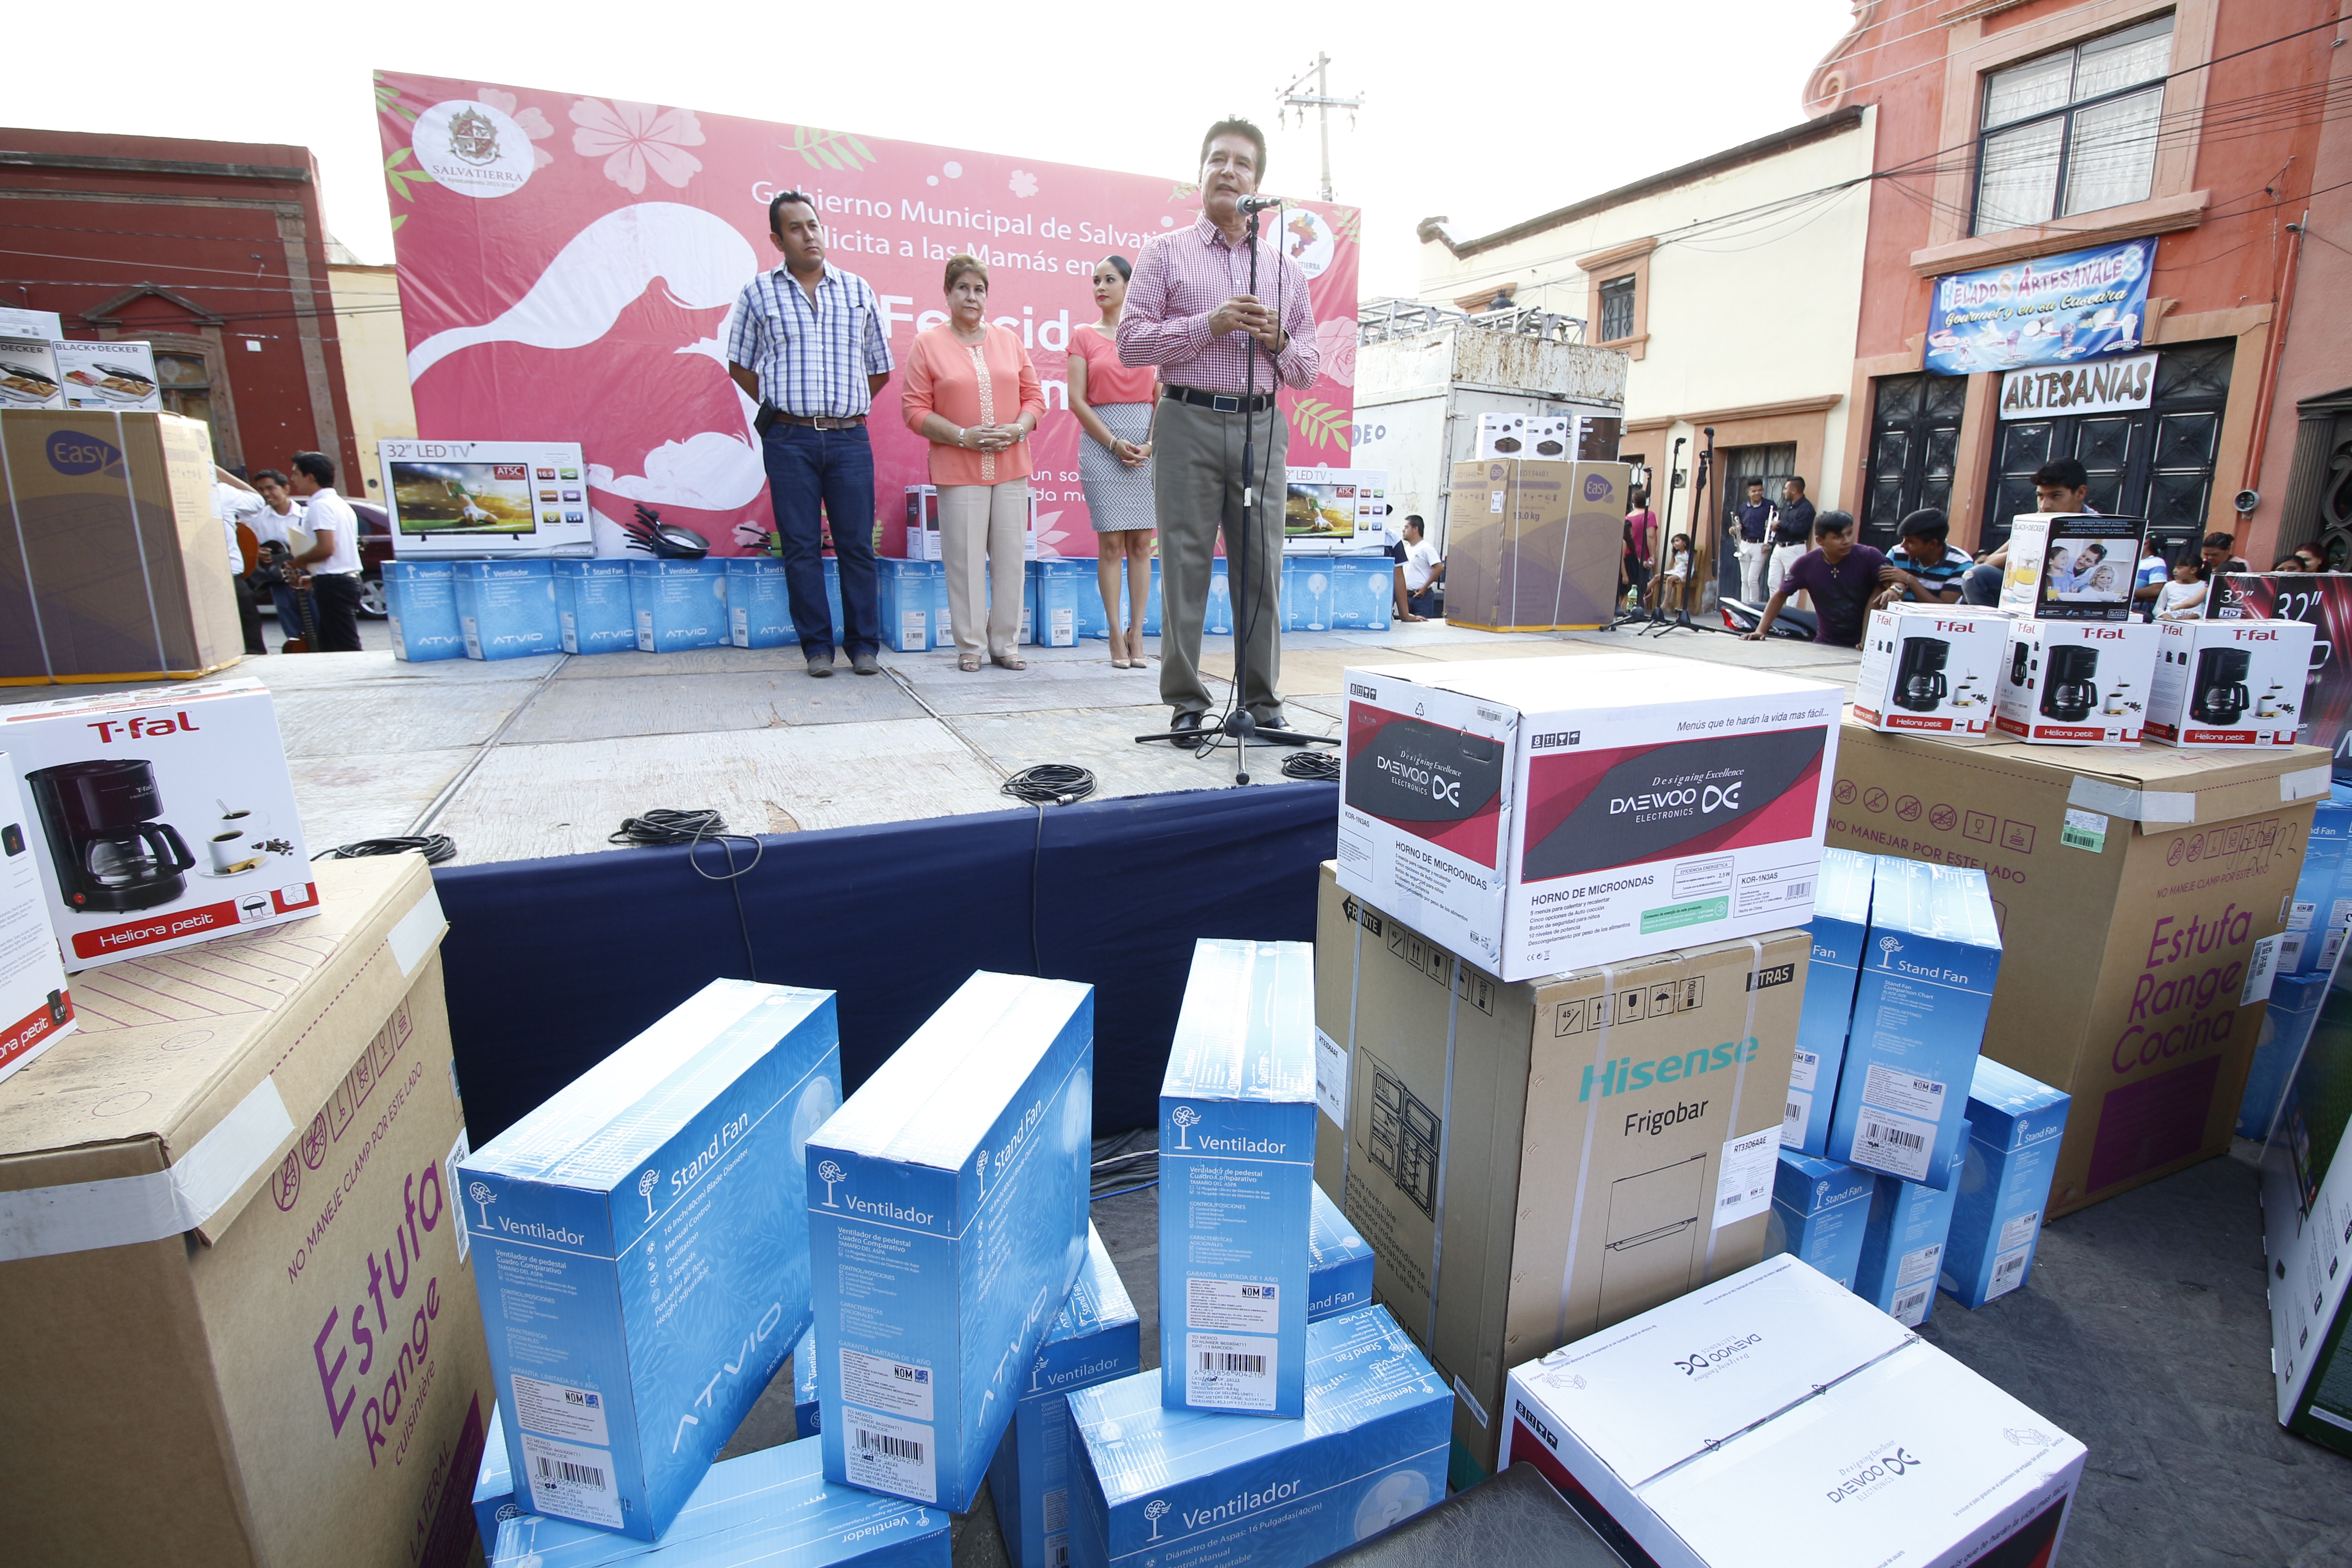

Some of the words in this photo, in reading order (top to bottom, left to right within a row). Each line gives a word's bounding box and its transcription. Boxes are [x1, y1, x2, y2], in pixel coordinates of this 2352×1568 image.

[432, 165, 524, 182] SALVATIERRA
[901, 198, 1032, 237] Municipal
[1040, 216, 1072, 240] de
[1079, 221, 1157, 250] Salvat
[823, 225, 890, 255] licita
[899, 239, 914, 258] a
[922, 236, 957, 262] las
[966, 242, 1058, 273] Mamás
[1065, 260, 1095, 277] en
[1298, 261, 1320, 270] TIERRA
[1941, 274, 2013, 311] HELADOS
[2017, 245, 2144, 298] ARTESANALES
[1945, 306, 2004, 328] Gourmet
[2003, 307, 2013, 320] y
[2017, 304, 2035, 316] en
[2037, 301, 2057, 313] su
[2060, 289, 2127, 310] Cascara
[55, 343, 139, 353] BLACK+DECKER
[2004, 362, 2151, 410] ARTESANIAS
[54, 442, 108, 468] Easy
[416, 445, 446, 458] LED
[449, 446, 470, 458] TV
[496, 467, 522, 476] ATSC
[1296, 470, 1313, 481] LED
[1314, 471, 1327, 481] TV
[1586, 480, 1609, 496] Easy
[2014, 524, 2045, 532] BLACK+DECKER
[593, 567, 611, 576] Stand
[666, 627, 707, 638] ATVIO
[1876, 614, 1892, 627] T-fal
[1934, 620, 1975, 633] T-fal
[2017, 622, 2036, 634] T-fal
[2081, 627, 2126, 639] T-fal
[2162, 624, 2183, 636] T-fal
[2232, 629, 2279, 641] T-fal
[493, 632, 543, 644] ATVIO
[87, 711, 200, 743] T-fal
[1677, 720, 1706, 732] Menús
[1708, 719, 1724, 730] que
[1726, 718, 1735, 727] te
[1736, 714, 1760, 726] harán
[1761, 713, 1769, 723] la
[1771, 712, 1787, 722] vida
[1789, 710, 1805, 720] mas
[1807, 708, 1829, 718] fácil...
[1896, 718, 1922, 727] Heliora
[1924, 718, 1942, 728] petit
[2225, 733, 2245, 742] petit
[1377, 755, 1429, 785] DAEWOO
[1652, 771, 1704, 787] Designing
[1705, 768, 1744, 780] Excellence
[1392, 776, 1428, 795] ELECTRONICS
[1610, 788, 1696, 815] DAEWOO
[1635, 807, 1694, 823] ELECTRONICS
[1396, 840, 1421, 859] HORNO
[1422, 853, 1432, 865] DE
[1434, 858, 1487, 890] MICROONDAS
[1828, 818, 1846, 832] NO
[1851, 824, 1908, 850] MANEJAR
[1912, 843, 1942, 860] POR
[1946, 852, 1979, 868] ESTE
[1984, 862, 2026, 883] LADO
[1531, 890, 1570, 906] HORNO
[1572, 887, 1586, 899] DE
[1588, 875, 1654, 896] MICROONDAS
[1741, 872, 1778, 885] KOR-1N3AS
[100, 922, 168, 948] Heliora
[172, 913, 214, 936] petit
[1347, 902, 1379, 933] FRNTE
[2145, 902, 2253, 969] Estufa
[1813, 945, 1836, 959] Fan
[1897, 960, 1940, 978] Stand
[1943, 970, 1968, 984] Fan
[2127, 960, 2242, 1024] Range
[21, 1017, 49, 1048] petit
[2112, 1009, 2235, 1074] Cocina
[1578, 1036, 1759, 1103] Hisense
[1625, 1099, 1709, 1137] Frigobar
[995, 1119, 1023, 1177] Stand
[1026, 1100, 1041, 1132] Fan
[1199, 1135, 1286, 1154] Ventilador
[1734, 1136, 1767, 1154] RT33D6AAE
[671, 1134, 718, 1196] Stand
[722, 1112, 748, 1147] Fan
[288, 1249, 305, 1285] NO
[307, 1186, 343, 1254] MANEJE
[343, 1141, 370, 1193] CLAMP
[372, 1115, 389, 1149] POR
[389, 1093, 405, 1122] ESTE
[401, 1062, 422, 1097] LADO
[1215, 1174, 1257, 1183] Comparativo
[664, 1224, 672, 1236] 16
[672, 1189, 706, 1228] Inch(40cm)
[707, 1173, 722, 1193] Blade
[723, 1148, 748, 1176] Diameter
[845, 1195, 934, 1225] Ventilador
[499, 1215, 585, 1245] Ventilador
[665, 1224, 688, 1253] Manual
[689, 1200, 711, 1227] Control
[666, 1231, 699, 1267] Oscillation
[669, 1275, 673, 1284] 3
[674, 1251, 696, 1279] Speeds
[314, 1158, 443, 1440] Estufa
[655, 1279, 682, 1316] Powerful
[683, 1272, 692, 1284] air
[692, 1257, 706, 1275] flow
[656, 1300, 678, 1328] Height
[679, 1266, 710, 1303] adjustable
[1242, 1287, 1259, 1297] NOM
[766, 1348, 784, 1375] MODEL
[978, 1285, 1047, 1428] ATVIO
[1047, 1356, 1119, 1386] Ventilador
[362, 1277, 440, 1470] Range
[672, 1302, 781, 1454] ATVIO
[395, 1360, 436, 1466] cuisinière
[410, 1440, 451, 1563] LATERAL
[1182, 1479, 1300, 1529] Ventilador
[1166, 1543, 1205, 1561] Diámetro
[1207, 1539, 1218, 1548] de
[1220, 1529, 1247, 1545] Aspas:
[1248, 1524, 1258, 1534] 16
[1260, 1502, 1322, 1530] Pulgadas(40cm)
